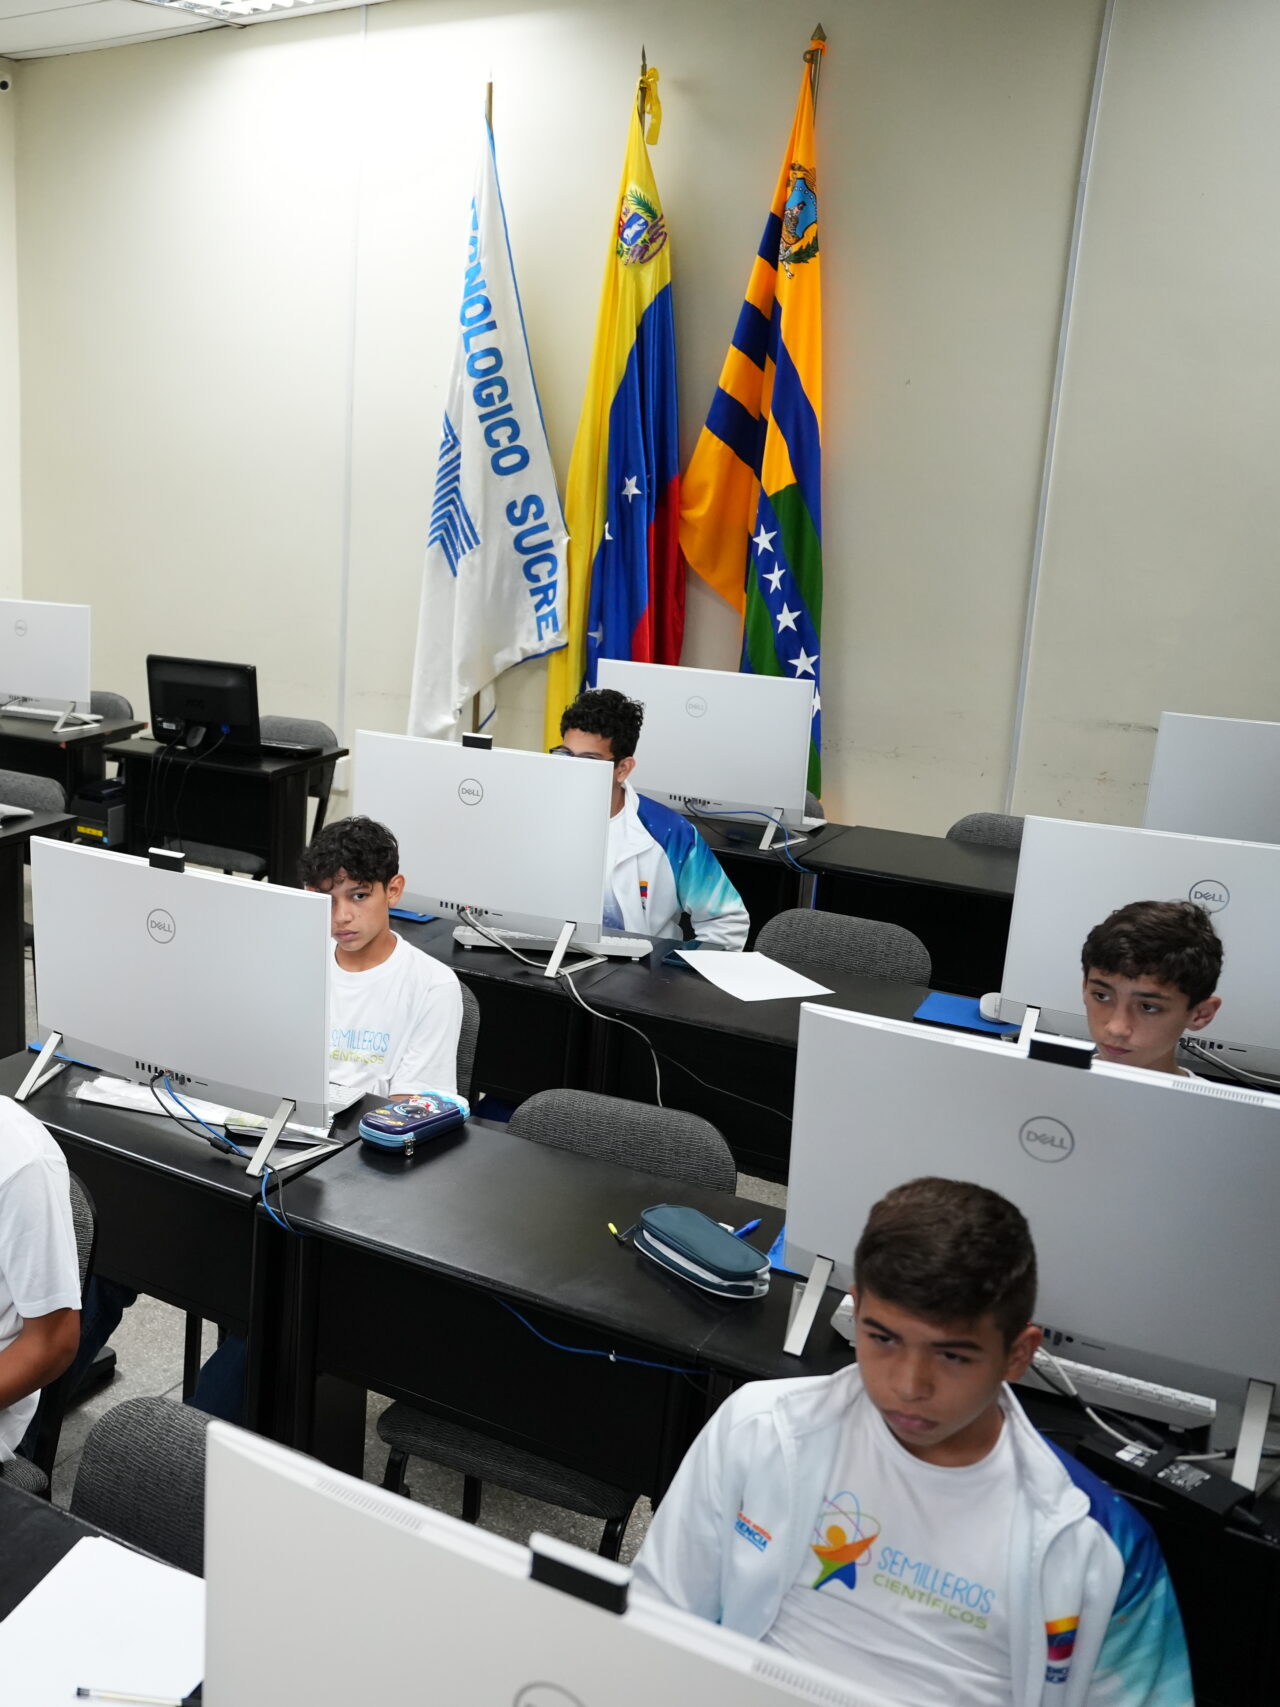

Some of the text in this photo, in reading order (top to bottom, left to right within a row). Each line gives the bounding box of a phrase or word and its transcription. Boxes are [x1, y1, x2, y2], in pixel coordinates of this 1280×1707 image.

[459, 197, 559, 641] NOLOGICO SUCRE
[460, 787, 480, 797] DELL
[1194, 890, 1224, 903] DELL
[150, 919, 173, 933] DELL
[1026, 1130, 1068, 1150] DELL
[877, 1546, 996, 1614] SEMILLEROS
